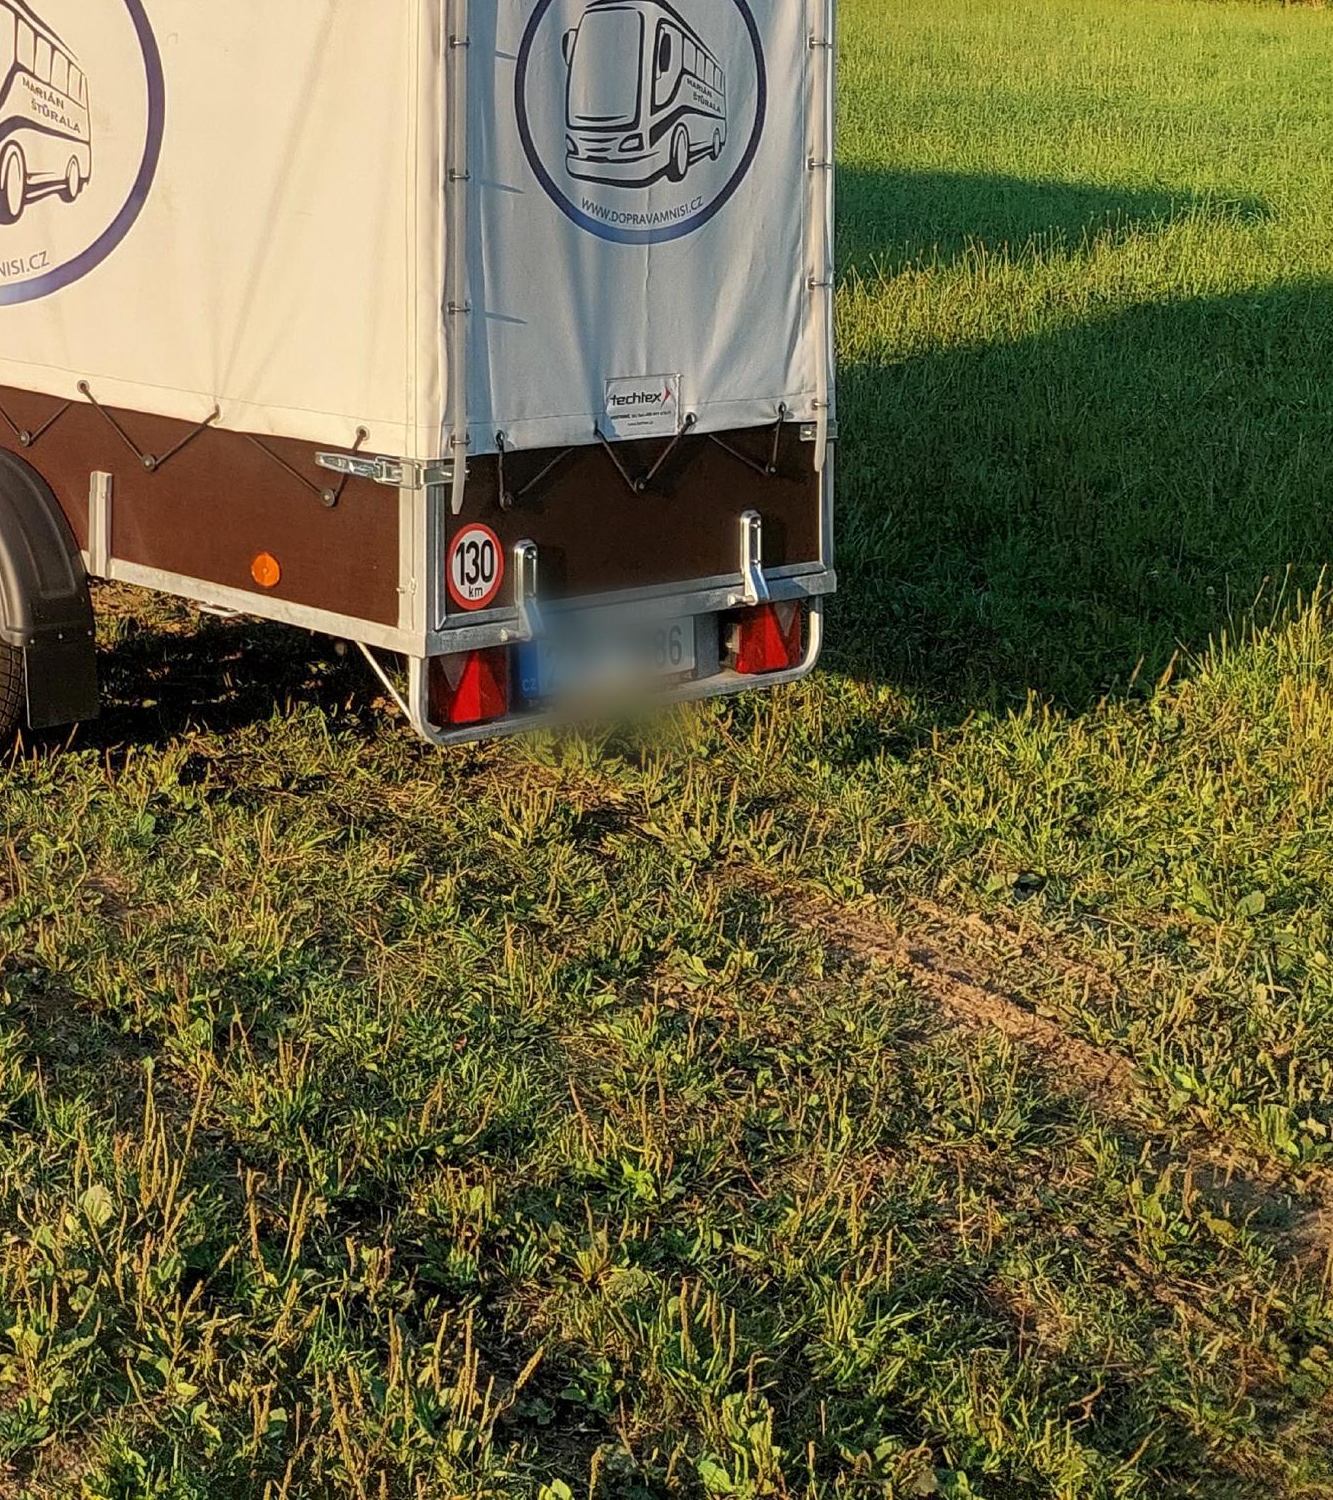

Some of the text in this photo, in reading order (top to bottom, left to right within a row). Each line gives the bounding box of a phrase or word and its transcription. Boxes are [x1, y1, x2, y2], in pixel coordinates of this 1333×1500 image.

[581, 195, 704, 225] WWW.DOPRAVAMNISI.CZ
[609, 391, 662, 406] techtex
[455, 538, 495, 587] 130
[468, 585, 484, 598] km
